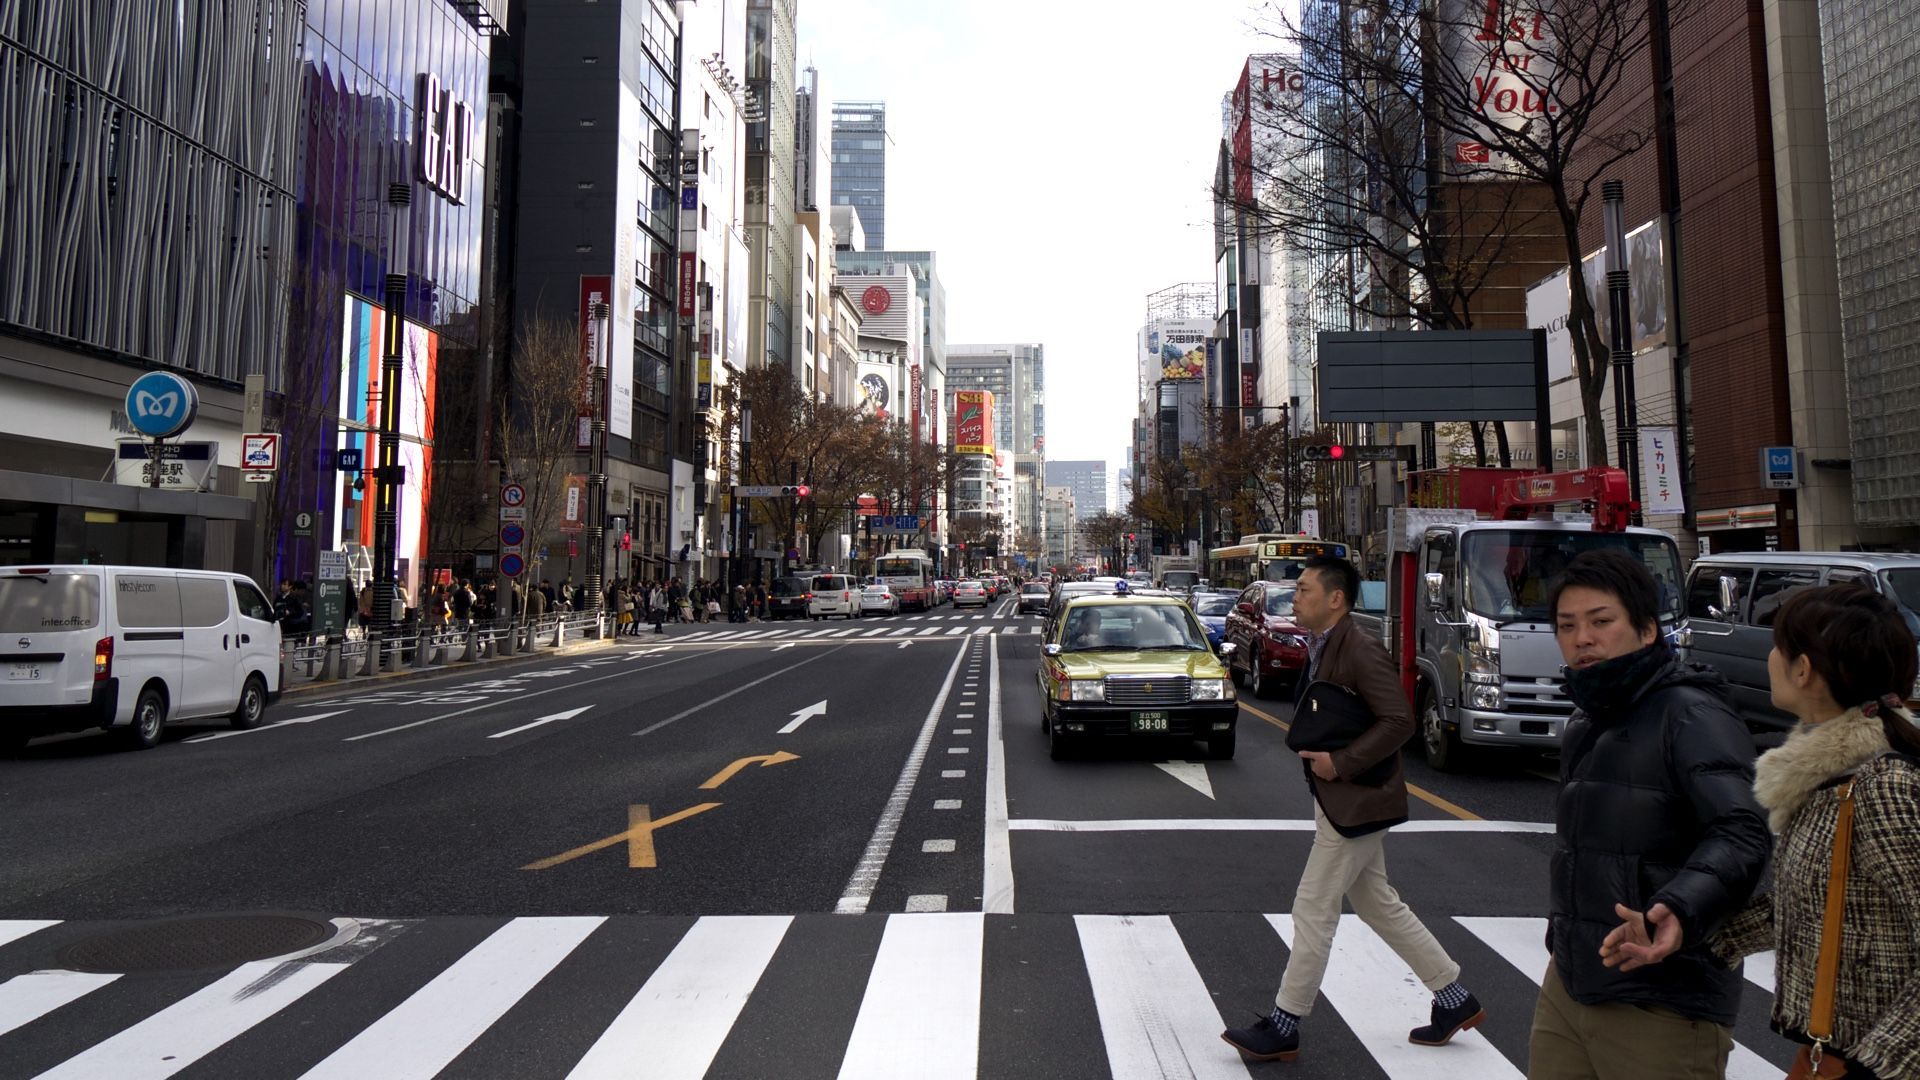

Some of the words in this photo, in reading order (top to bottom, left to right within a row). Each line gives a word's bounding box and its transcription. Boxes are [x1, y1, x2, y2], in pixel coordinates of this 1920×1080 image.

[1475, 0, 1545, 41] 1st
[1490, 46, 1537, 71] for
[1475, 76, 1557, 113] You.
[424, 71, 475, 206] GAP
[1538, 314, 1569, 335] ACH
[1166, 335, 1204, 344] 万田酵素
[959, 392, 983, 403] S&B
[342, 455, 357, 465] GAP
[1555, 448, 1581, 461] Bea
[1653, 437, 1670, 501] ヒカリミチ
[1139, 719, 1167, 729] 98-08
